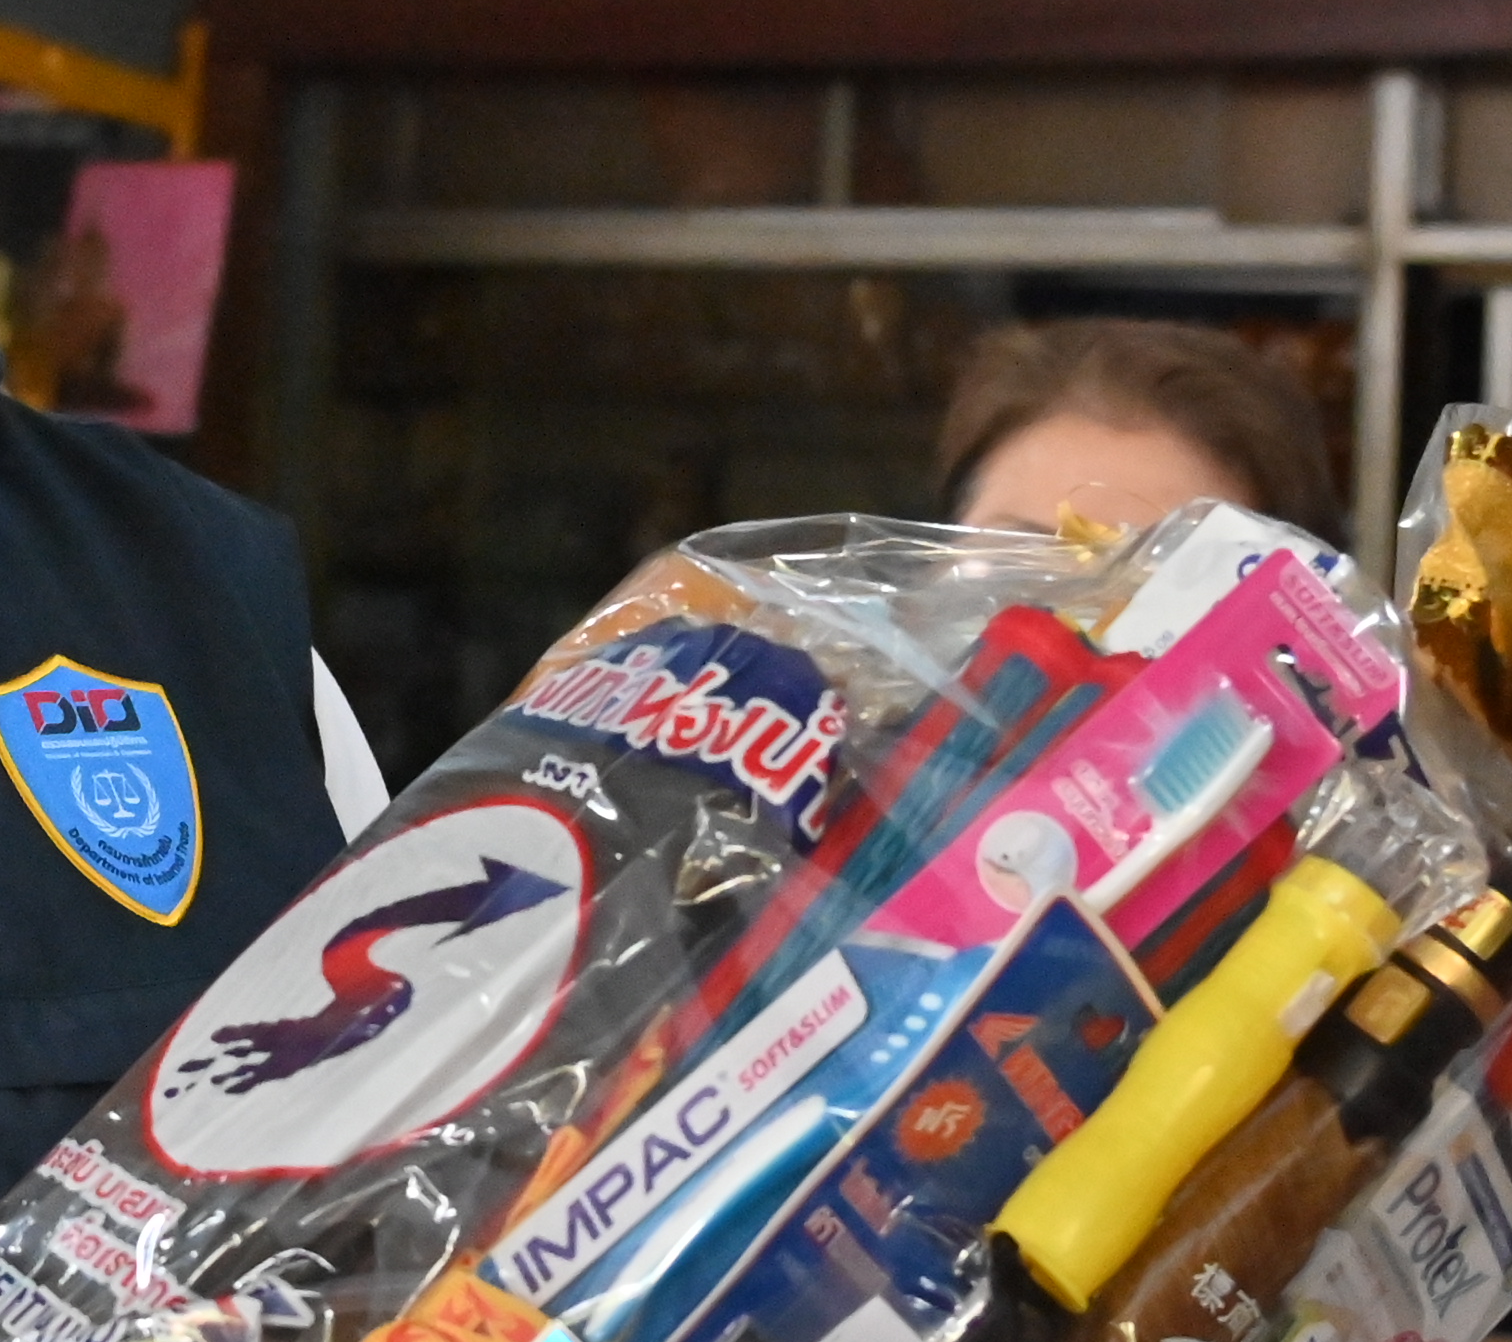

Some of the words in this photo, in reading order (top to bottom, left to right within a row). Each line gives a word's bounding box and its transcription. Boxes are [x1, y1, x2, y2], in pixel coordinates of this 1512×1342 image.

[68, 827, 142, 885] Department
[142, 871, 156, 887] of
[153, 854, 186, 886] Internal
[176, 821, 191, 855] Trade
[512, 1085, 731, 1295] IMPAC
[737, 984, 853, 1094] SOFT&SLIM
[1384, 1163, 1492, 1320] Protex
